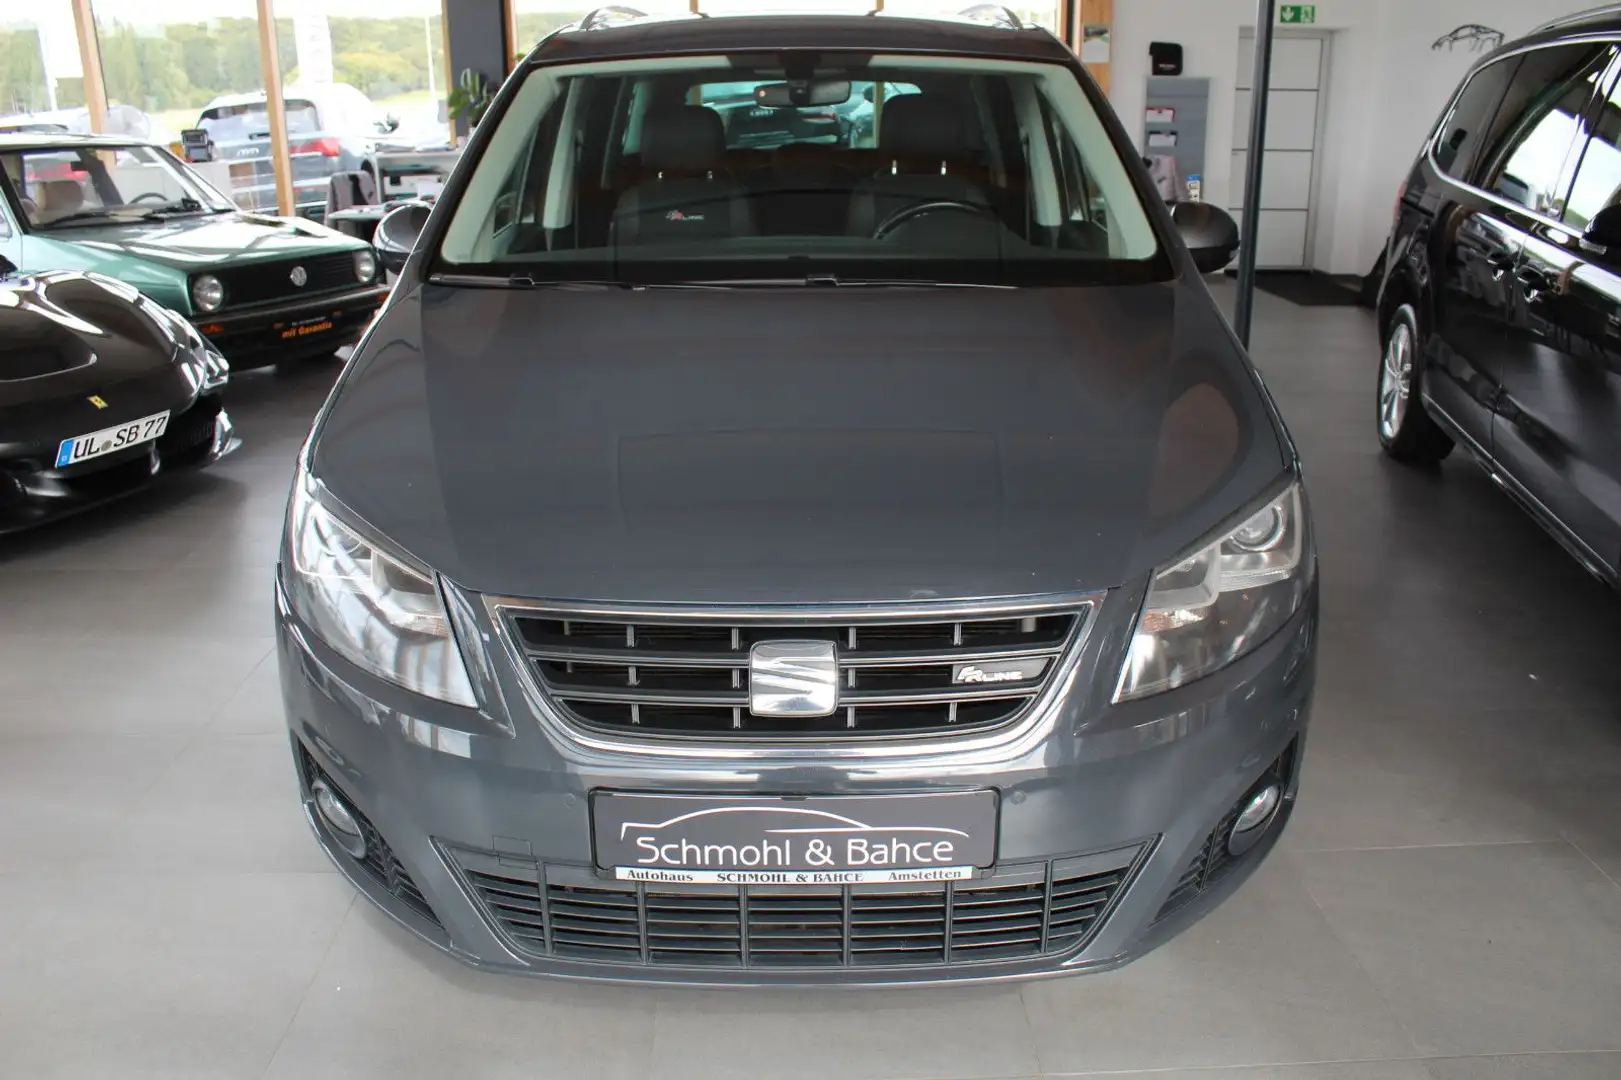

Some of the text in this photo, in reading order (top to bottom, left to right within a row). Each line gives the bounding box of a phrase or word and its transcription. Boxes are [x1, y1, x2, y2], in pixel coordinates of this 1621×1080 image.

[74, 416, 167, 459] UL SB 77
[636, 836, 955, 866] Schmohl & Bahce
[627, 869, 962, 883] Autohaus SCHMOHL & BAHCE Amstetten
